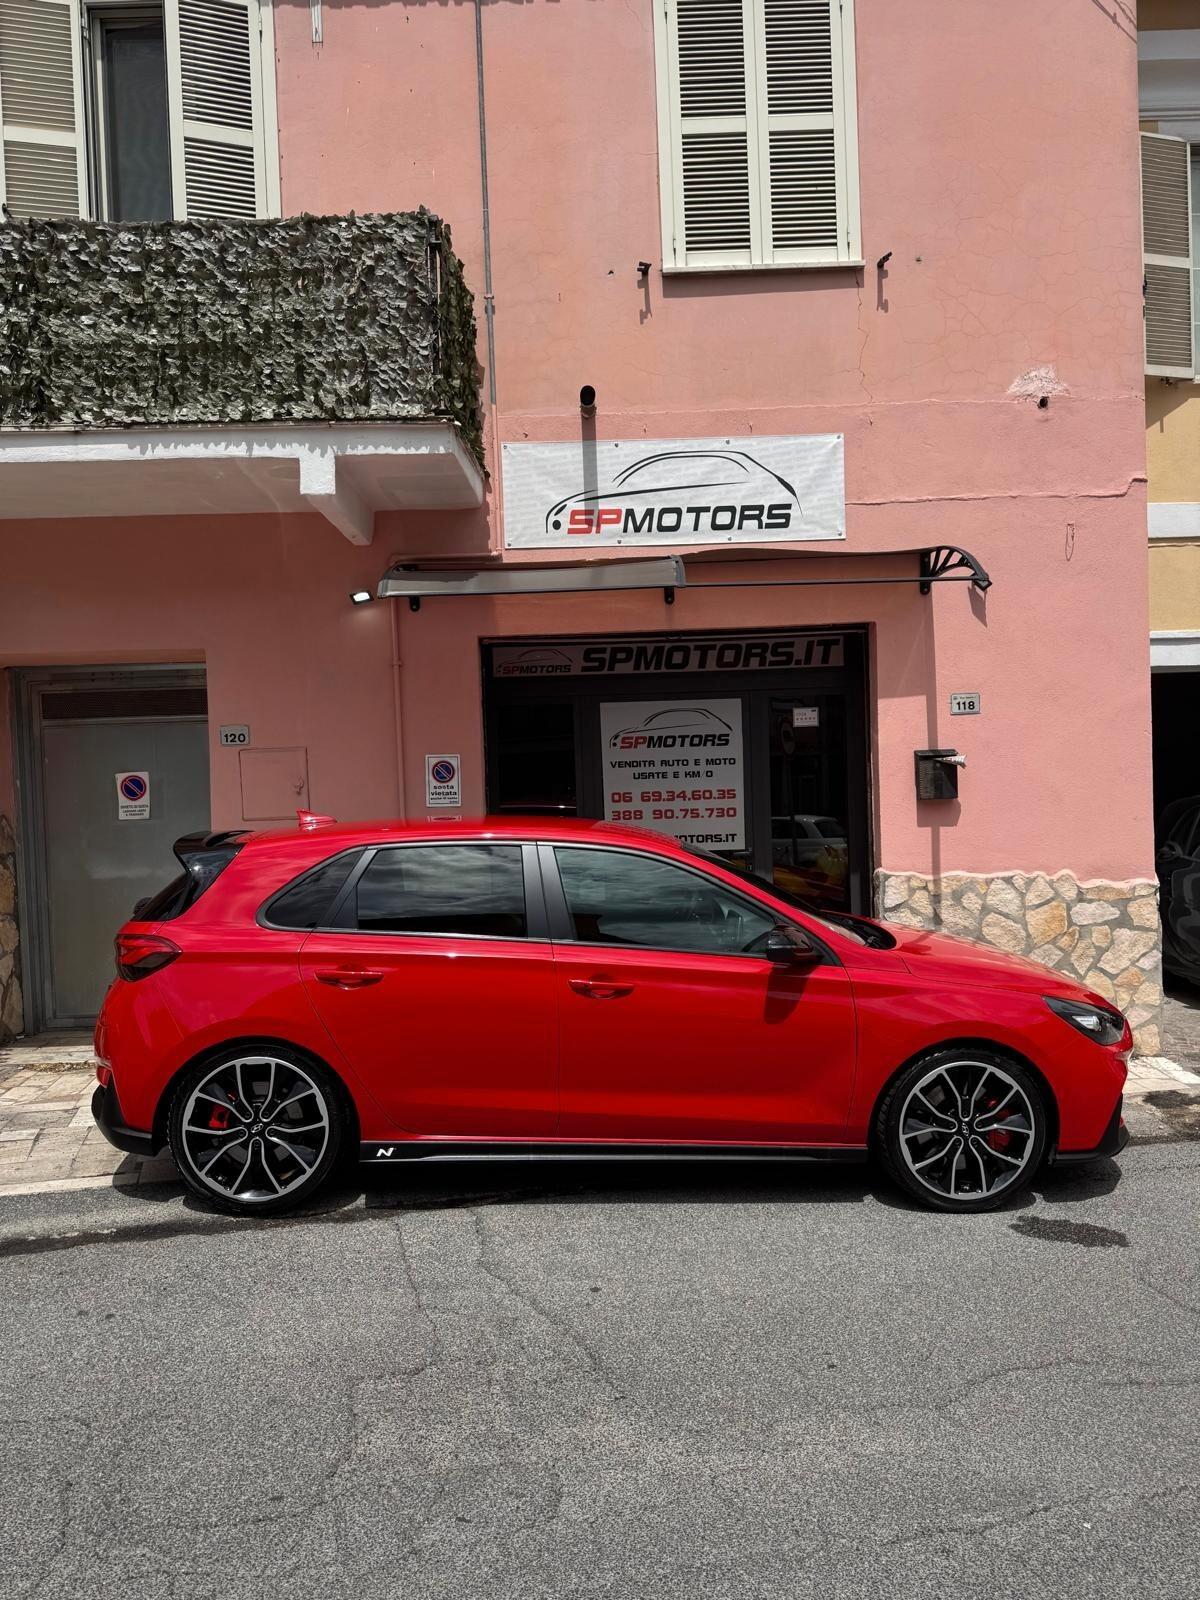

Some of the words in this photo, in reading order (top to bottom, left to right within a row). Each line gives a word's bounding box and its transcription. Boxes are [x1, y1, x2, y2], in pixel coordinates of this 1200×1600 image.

[567, 503, 792, 534] SPMOTORS
[502, 664, 572, 674] SPMOTORS
[580, 639, 840, 672] SPMOTORS.IT
[956, 700, 976, 711] 118
[223, 733, 246, 743] 120
[619, 733, 731, 750] SPMOTORS
[610, 760, 656, 769] VENDITA
[660, 758, 689, 767] AUTO
[694, 758, 701, 766] E
[705, 757, 736, 766] MOTO
[632, 771, 668, 780] USATE
[672, 771, 680, 779] E
[611, 791, 633, 803] 06
[640, 788, 737, 803] 69.34.60.35
[612, 809, 644, 821] 388
[652, 807, 737, 820] 90.75.730
